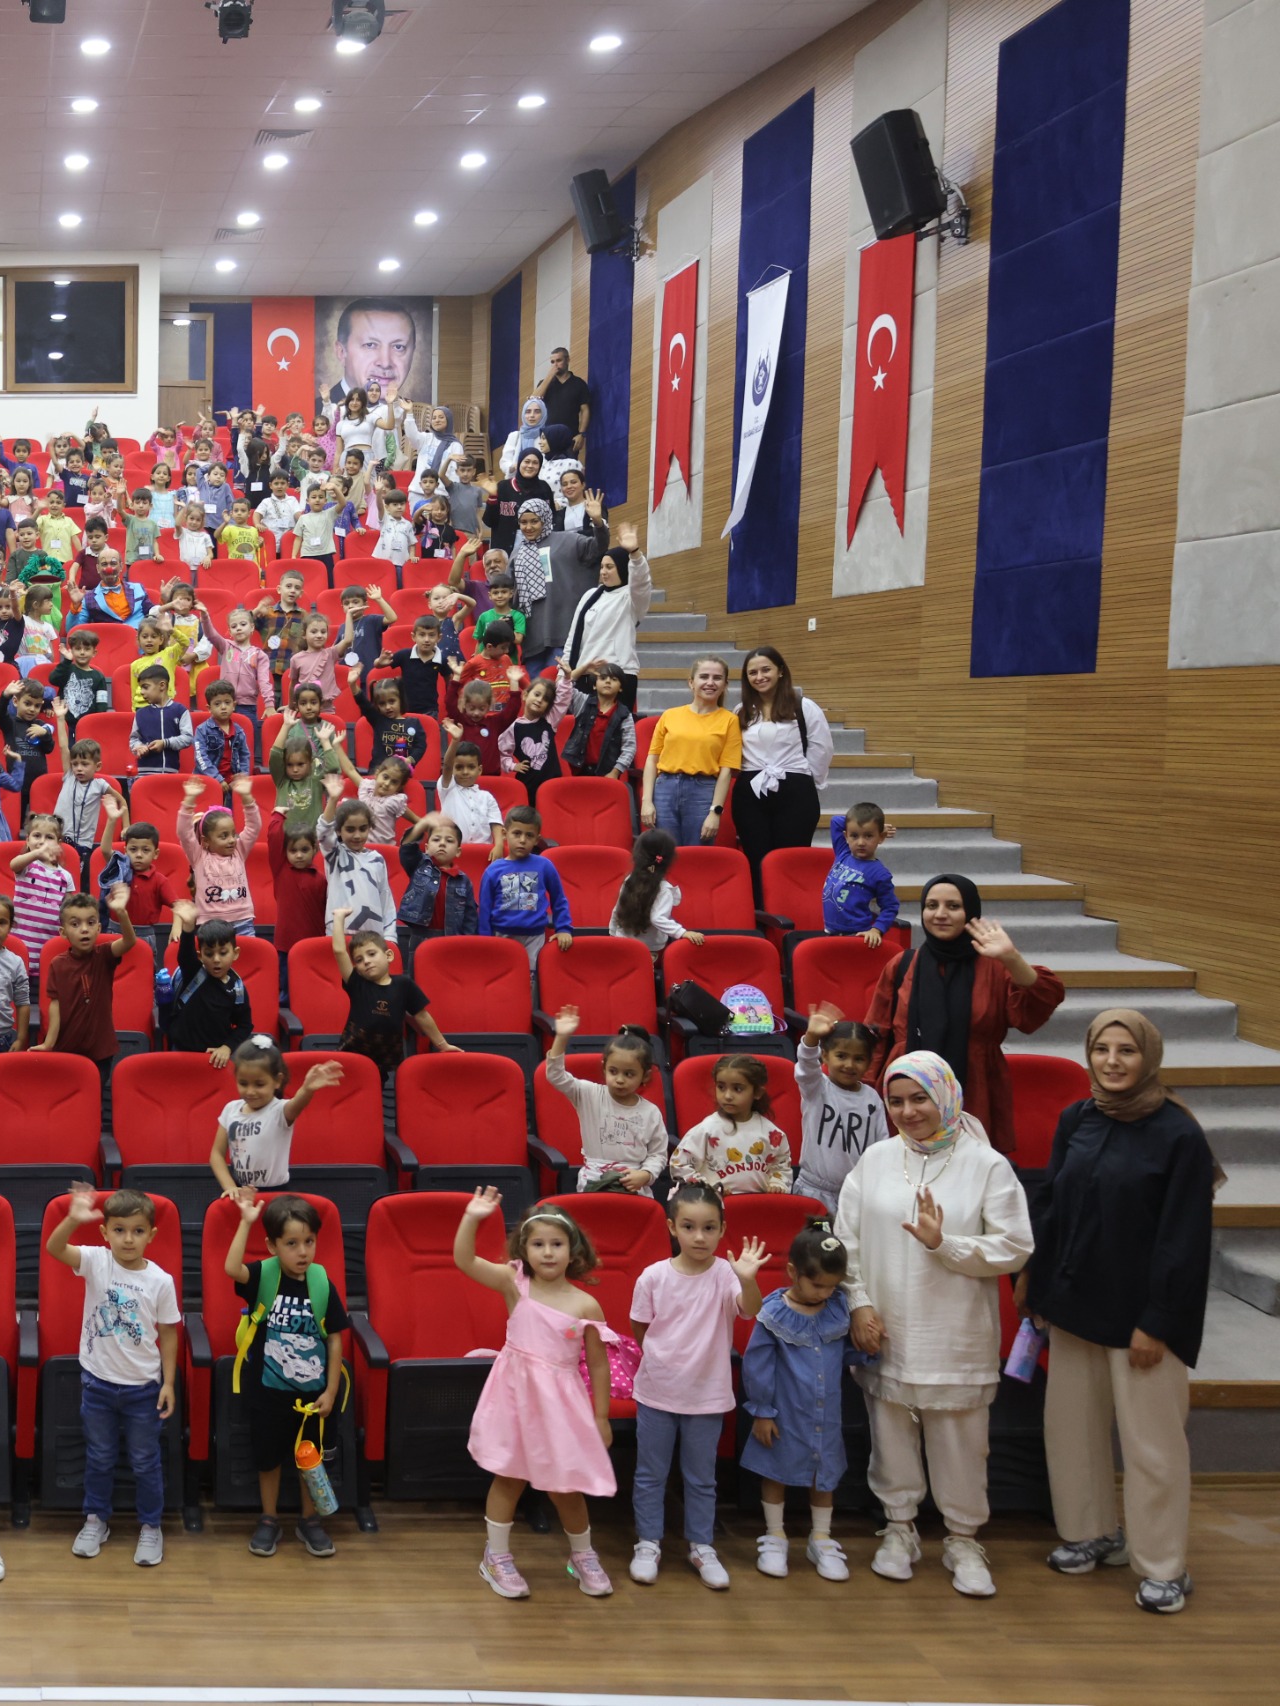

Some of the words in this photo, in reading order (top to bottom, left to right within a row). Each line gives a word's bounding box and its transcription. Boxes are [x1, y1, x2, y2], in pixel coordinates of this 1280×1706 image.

[237, 1121, 262, 1137] THIS
[237, 1169, 267, 1185] HAPPY
[716, 1162, 770, 1179] BONJOU
[124, 1283, 134, 1291] THE
[267, 1312, 289, 1326] ACE
